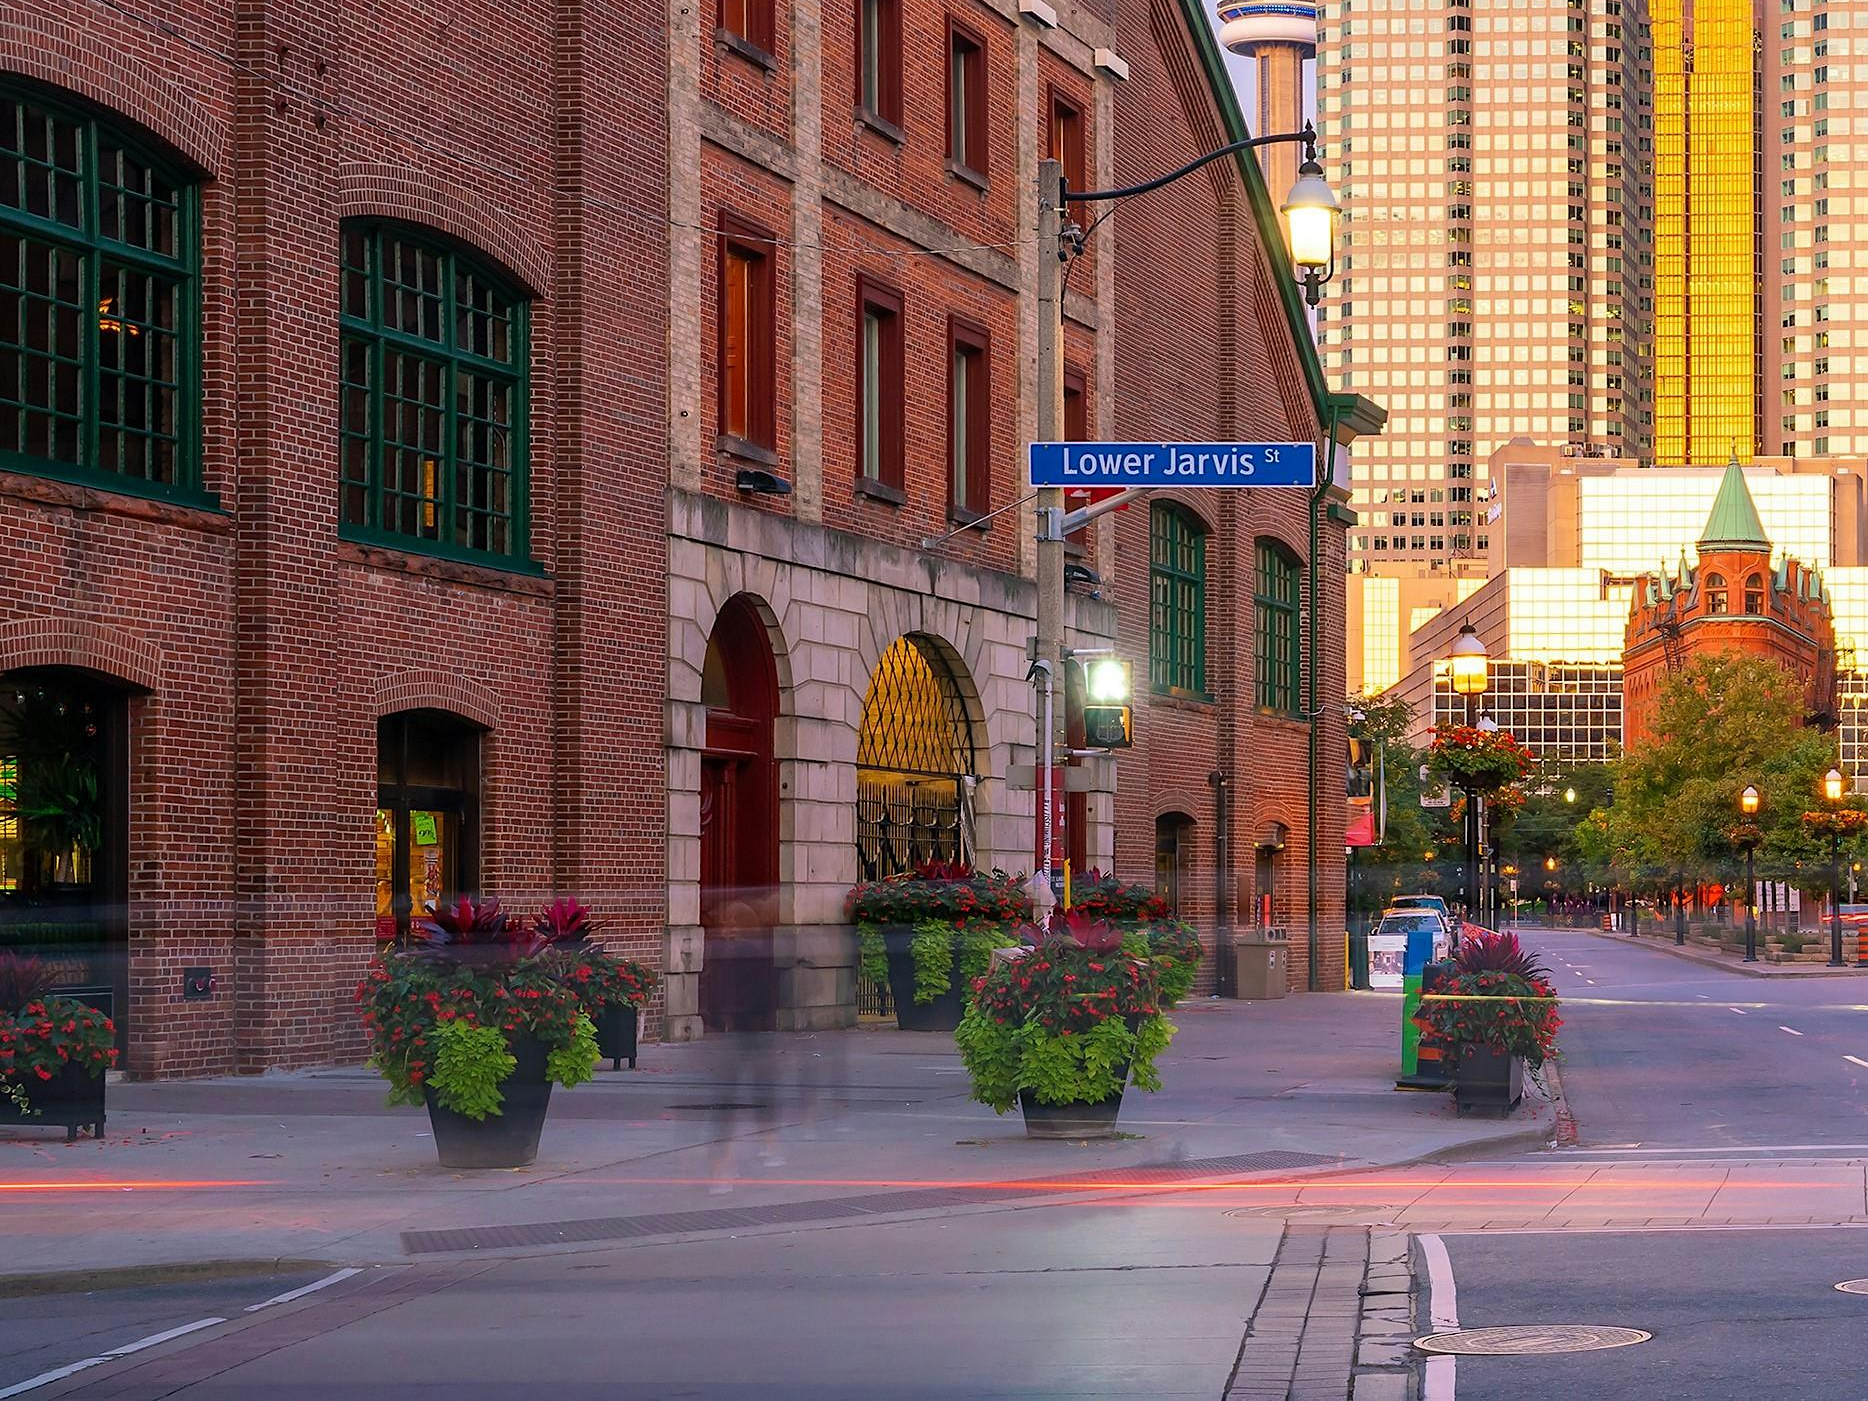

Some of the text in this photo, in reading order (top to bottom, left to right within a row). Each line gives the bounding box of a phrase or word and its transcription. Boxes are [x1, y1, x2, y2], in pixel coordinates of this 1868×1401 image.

[1063, 447, 1280, 476] Lower Jarvis St
